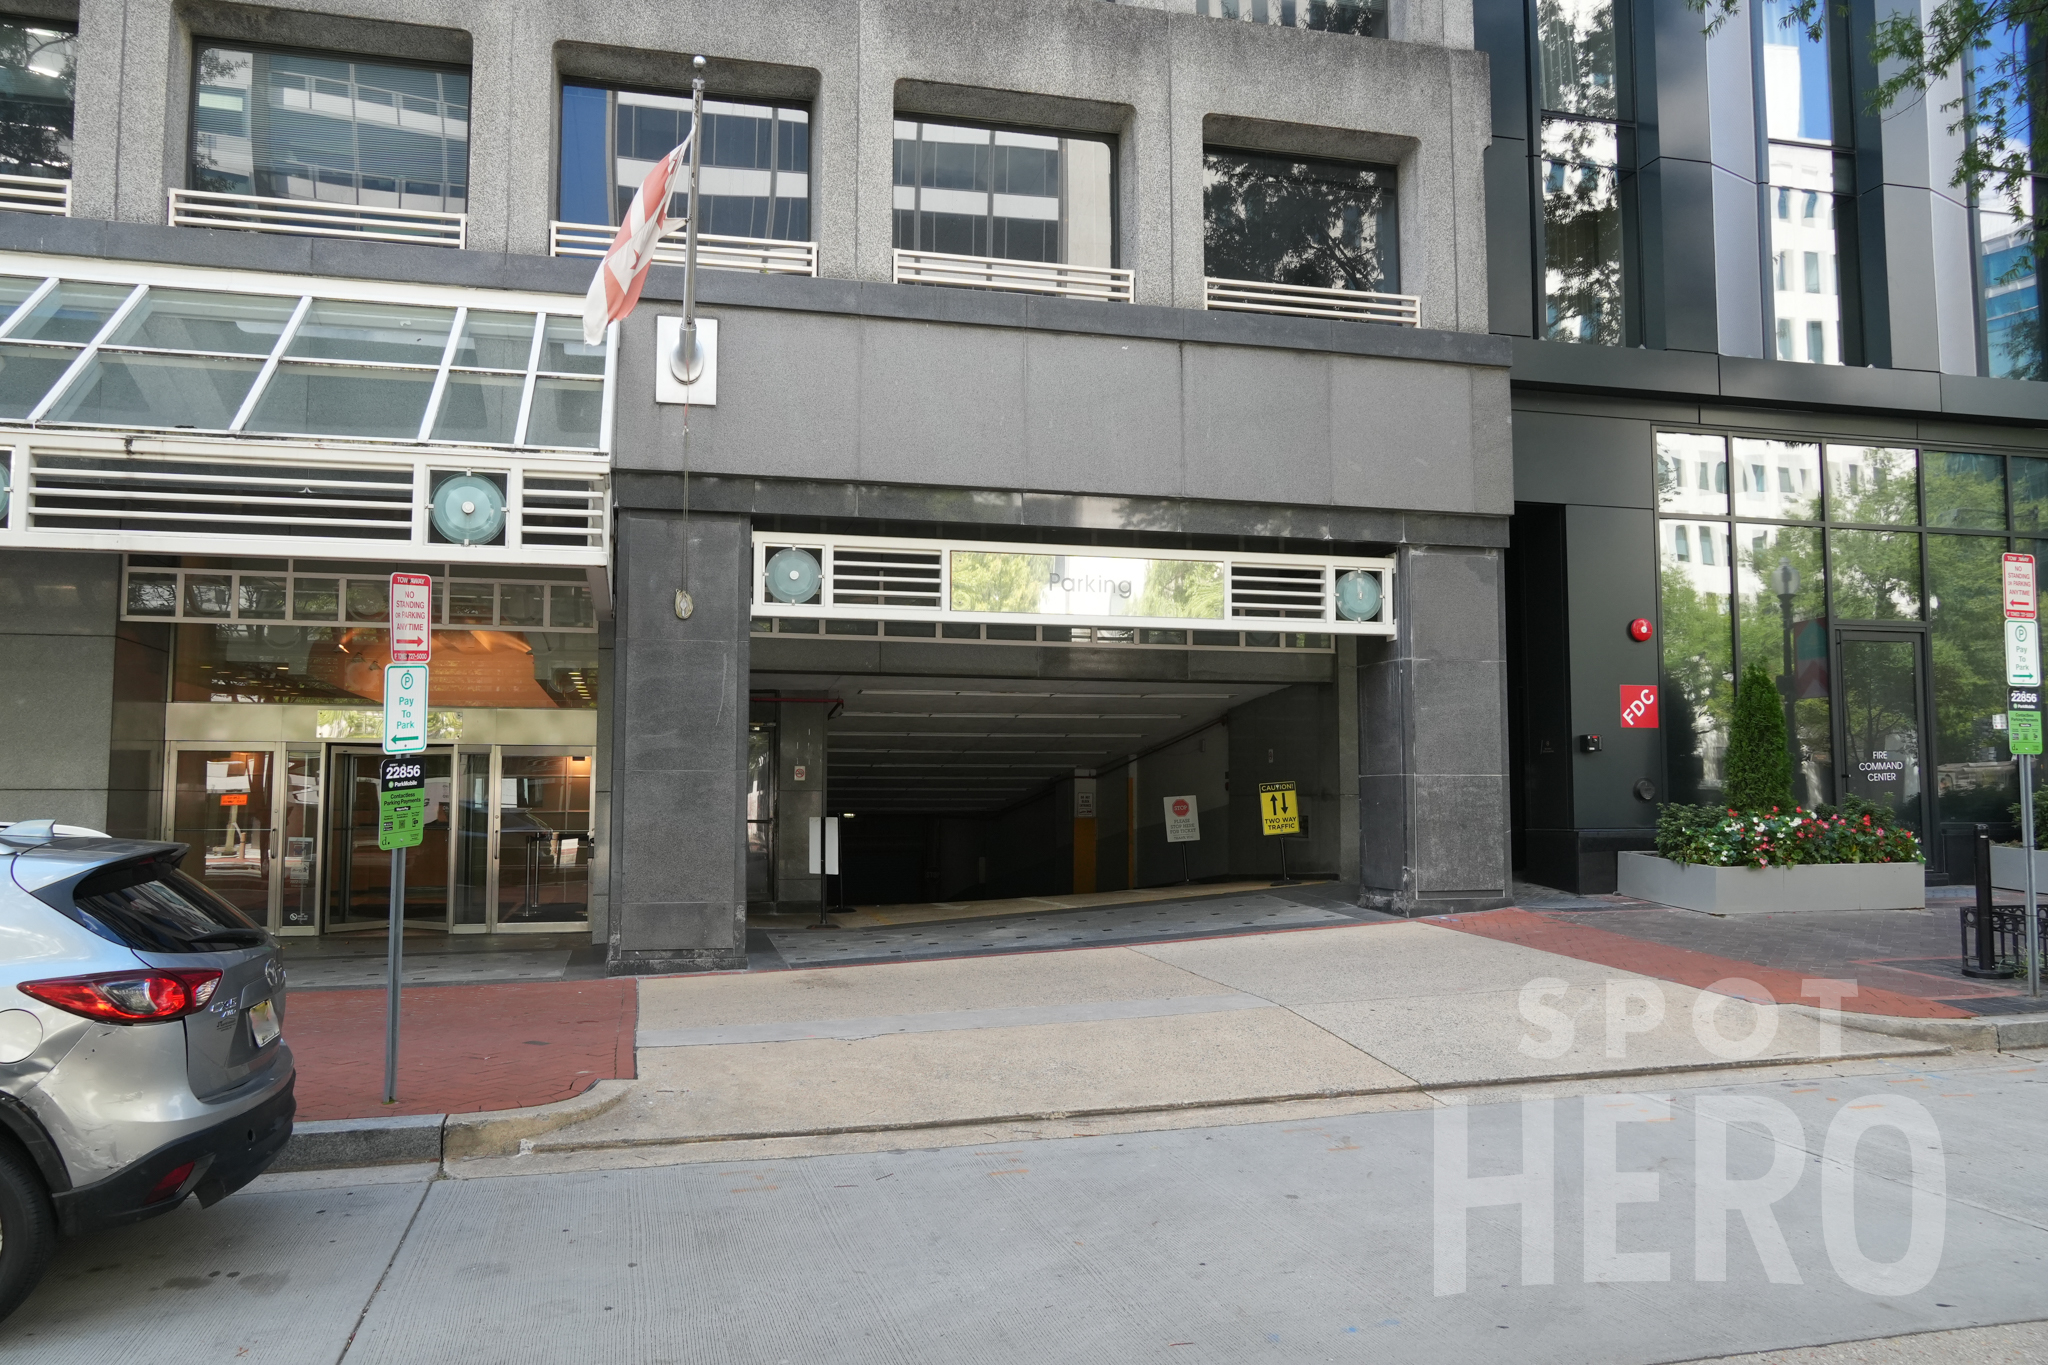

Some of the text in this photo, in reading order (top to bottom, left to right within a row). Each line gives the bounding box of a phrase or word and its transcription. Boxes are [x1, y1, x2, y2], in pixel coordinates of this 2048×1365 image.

[397, 576, 408, 584] TOW
[1049, 572, 1131, 599] Parking
[396, 600, 424, 609] STANDING
[402, 611, 425, 619] PARKING
[396, 623, 424, 631] ANYTIME
[2019, 629, 2024, 638] P
[2016, 646, 2027, 654] Pay
[405, 676, 410, 686] P
[399, 697, 414, 707] Pay
[2011, 693, 2037, 702] 22856
[1622, 689, 1654, 725] FDC
[402, 710, 411, 718] To
[397, 721, 414, 729] Park
[1873, 751, 1888, 759] FIRE
[1859, 762, 1903, 771] COMMAND
[386, 765, 420, 779] 22856
[1867, 773, 1896, 782] CENTER
